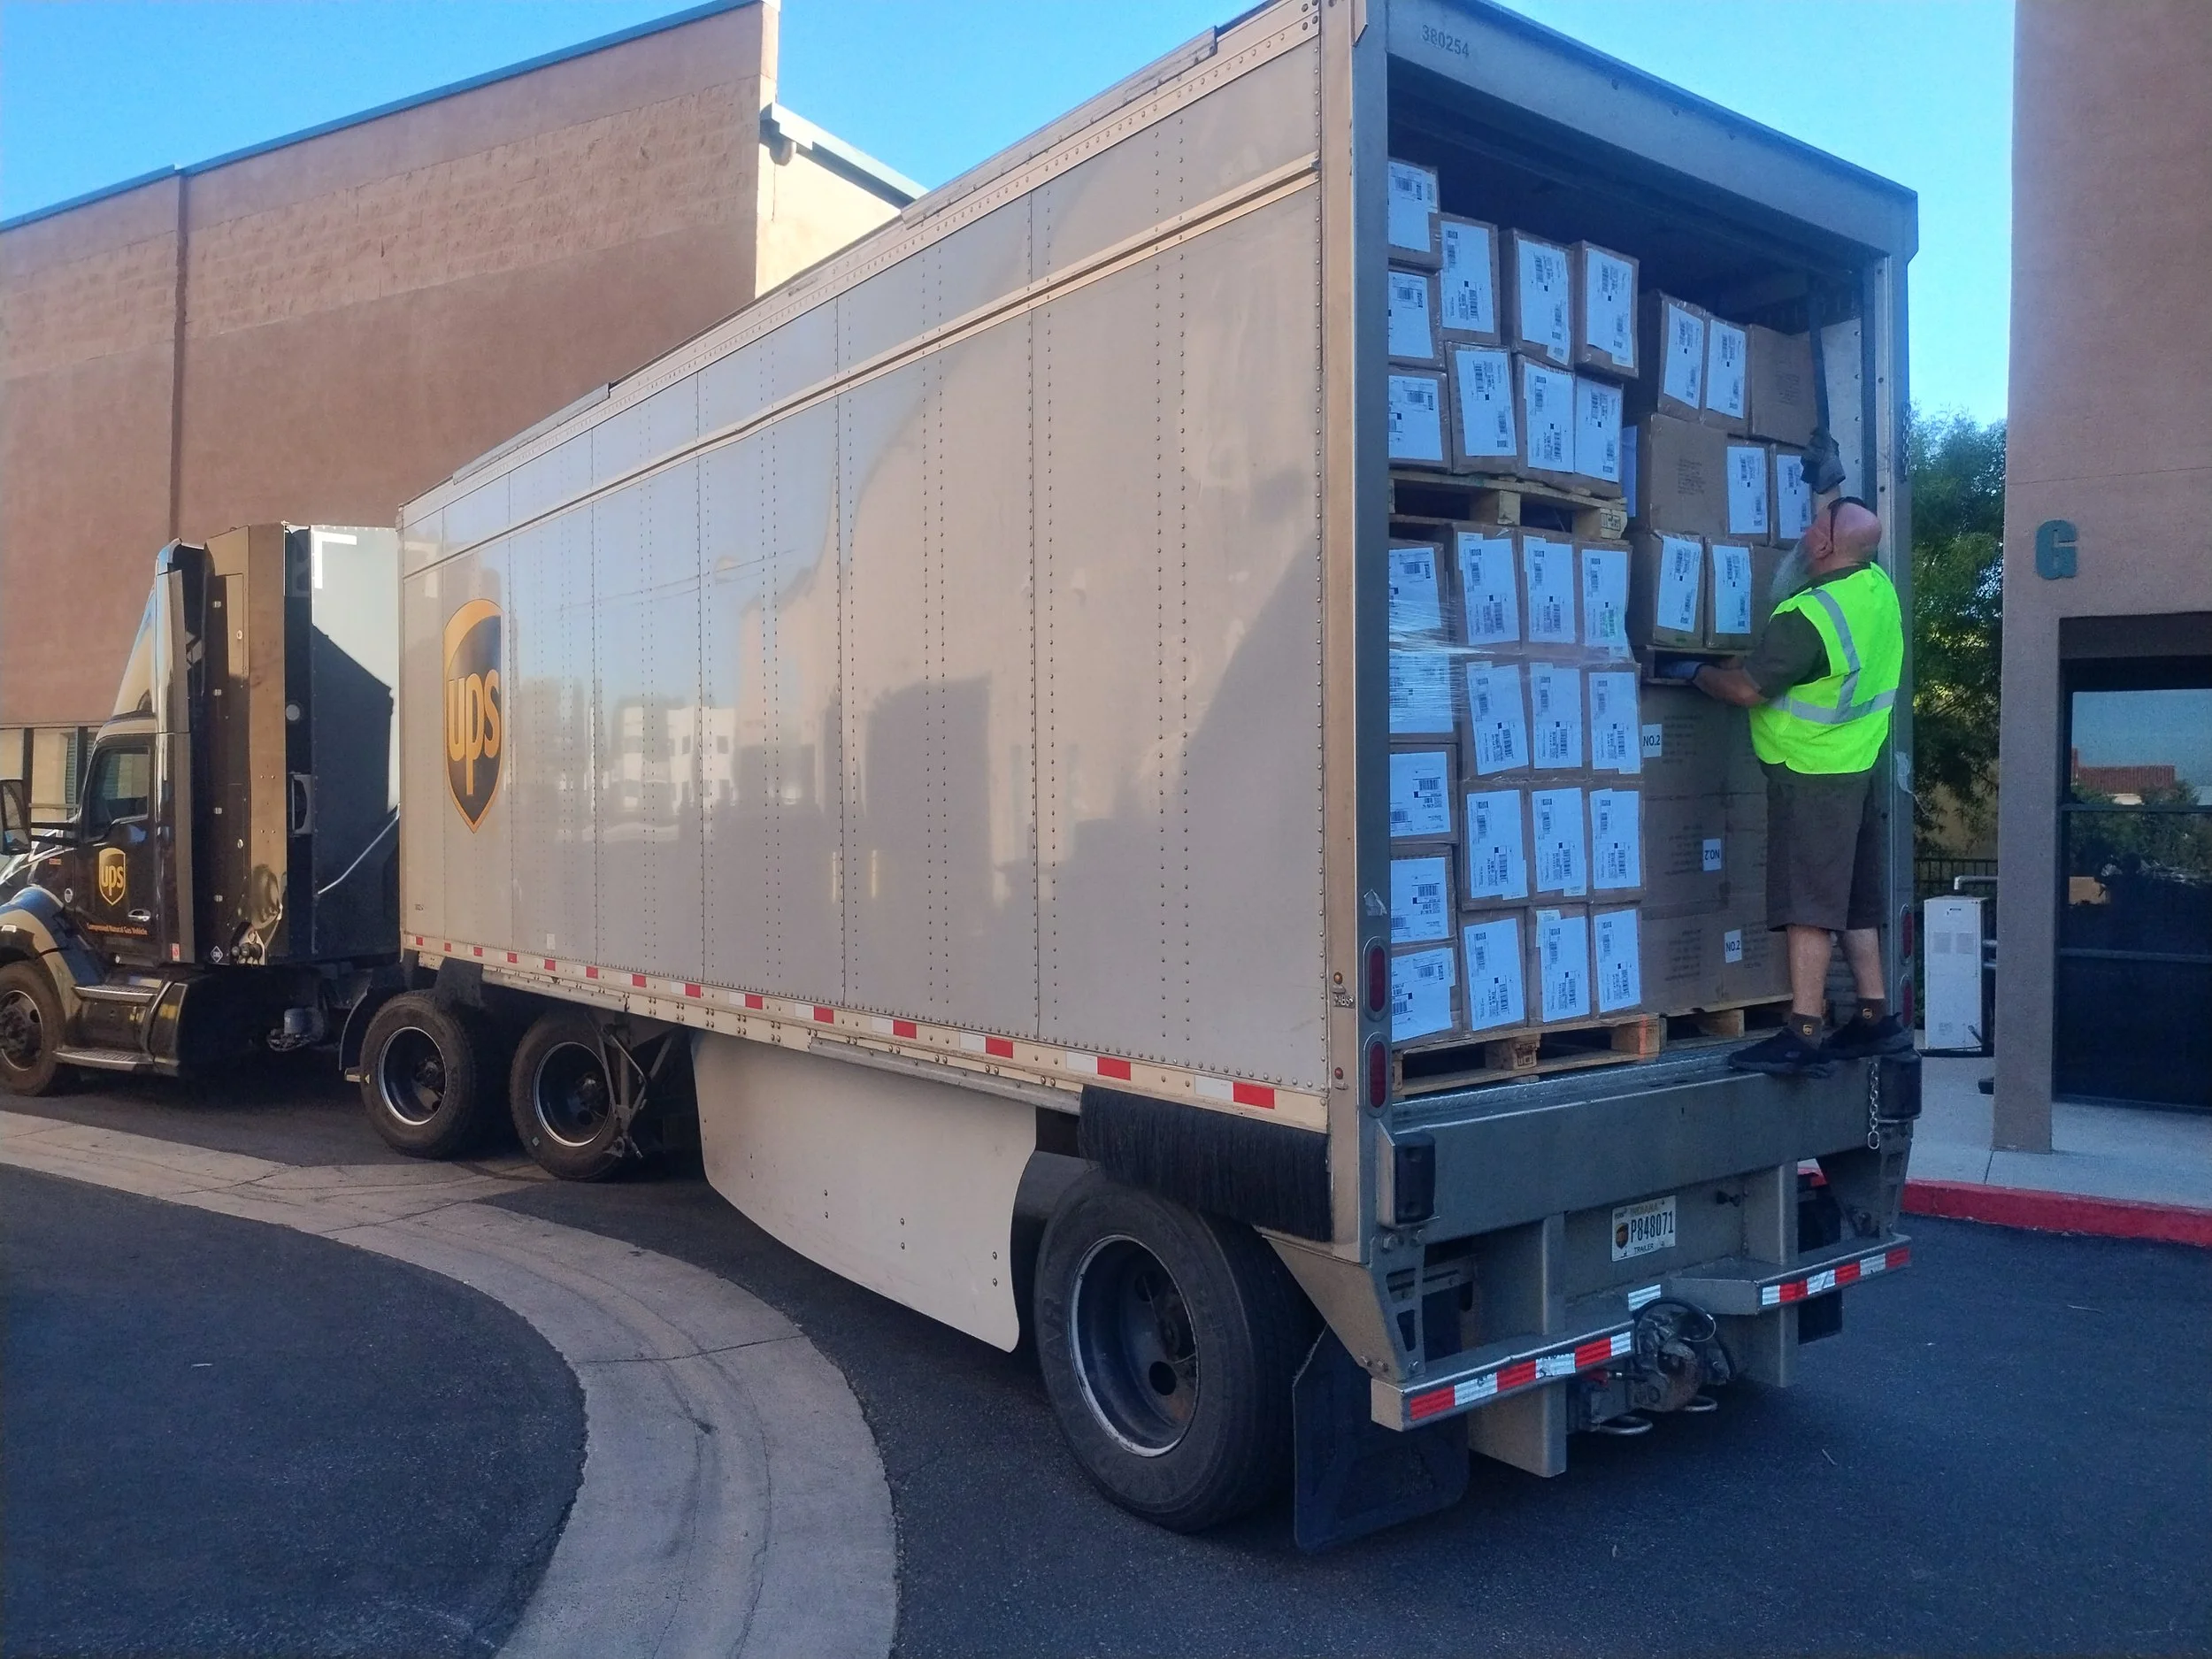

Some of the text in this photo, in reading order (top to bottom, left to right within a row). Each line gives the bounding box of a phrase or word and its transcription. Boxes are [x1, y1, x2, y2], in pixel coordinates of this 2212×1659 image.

[1421, 24, 1469, 58] 380254
[2036, 518, 2077, 580] G
[1643, 734, 1661, 747] NO.2
[1704, 849, 1720, 861] NO.2
[1725, 941, 1740, 953] NO.2
[1630, 1210, 1673, 1243] P848071
[1633, 1242, 1655, 1254] TRAILER
